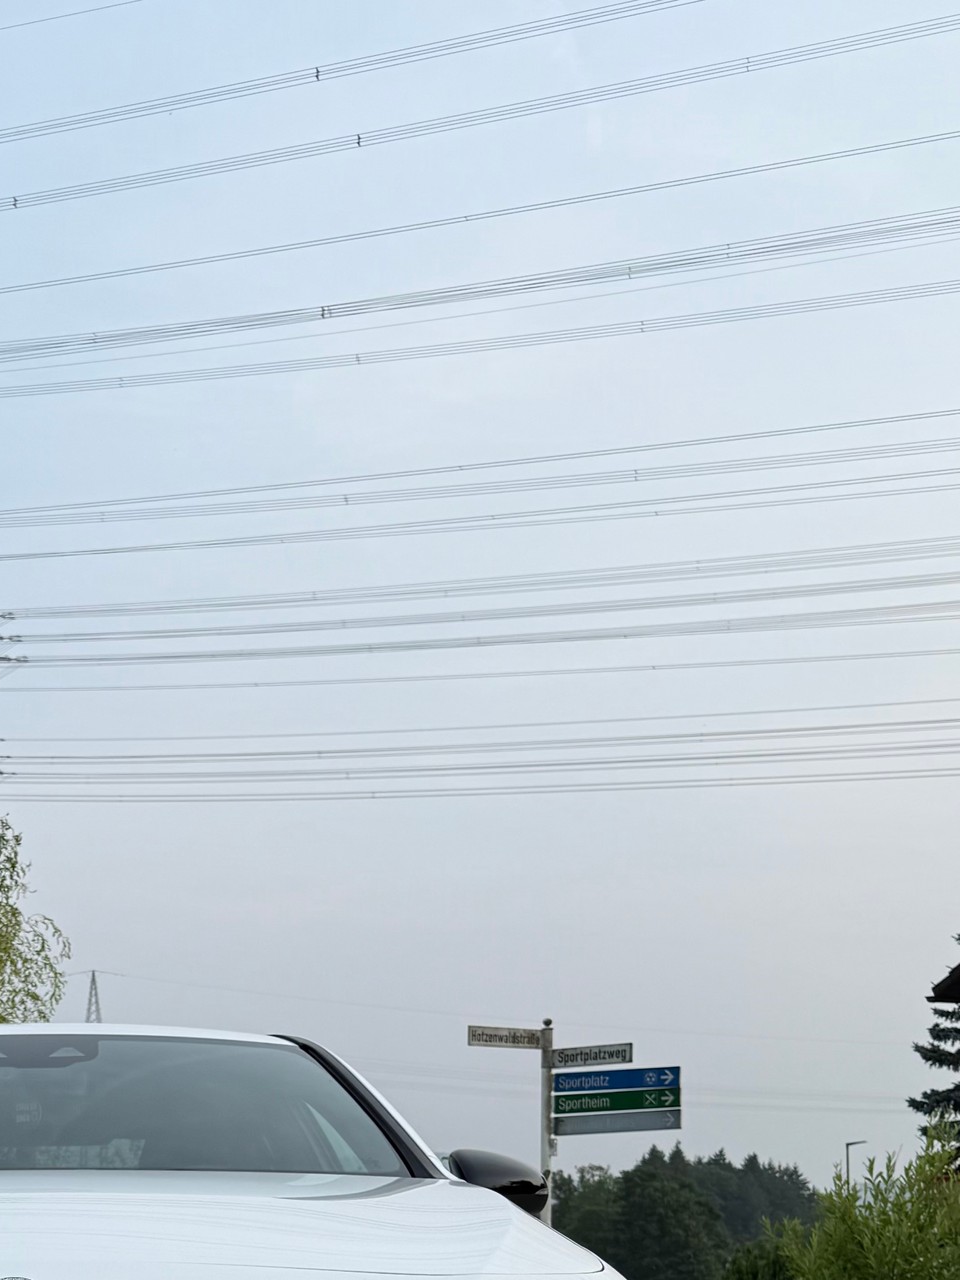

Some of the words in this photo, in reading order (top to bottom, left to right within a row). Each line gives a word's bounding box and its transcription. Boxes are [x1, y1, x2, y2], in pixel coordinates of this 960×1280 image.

[471, 1029, 540, 1046] Hotzenwaldstraße
[557, 1047, 627, 1065] Sportplatzweg
[558, 1075, 609, 1090] Sportplatz
[558, 1096, 610, 1111] Sportheim
